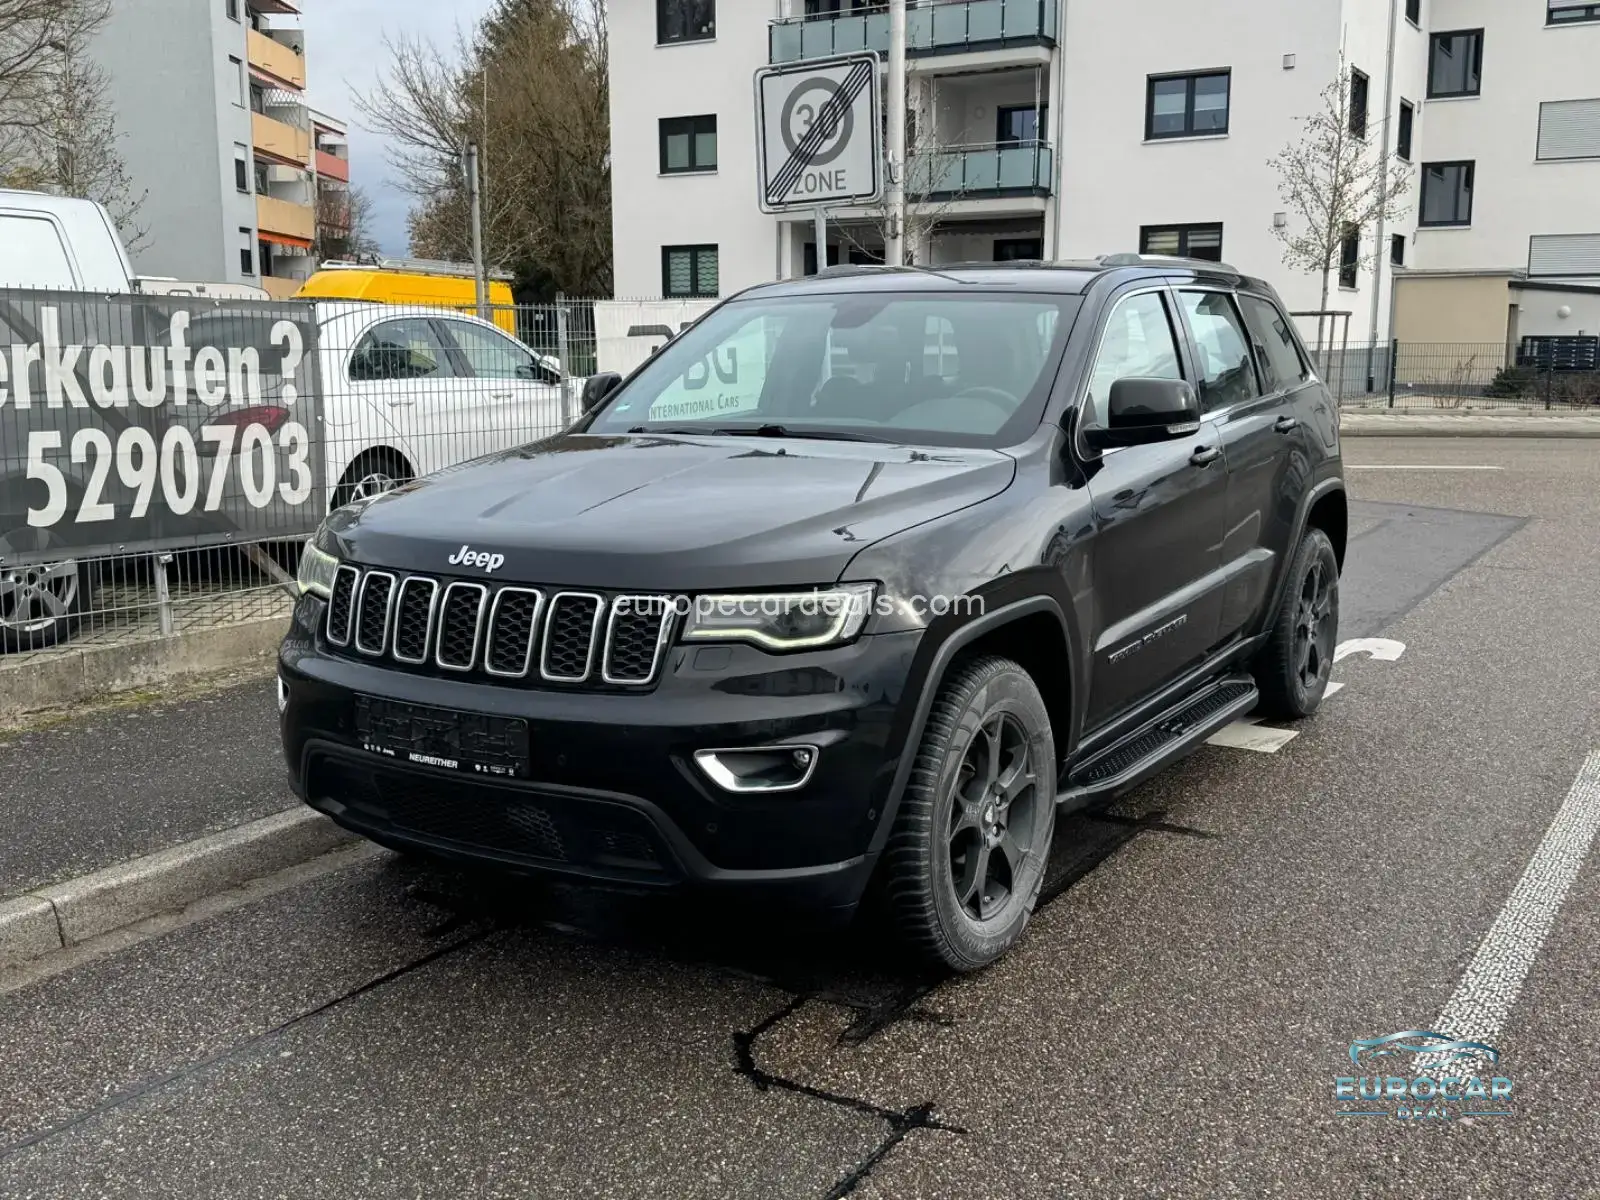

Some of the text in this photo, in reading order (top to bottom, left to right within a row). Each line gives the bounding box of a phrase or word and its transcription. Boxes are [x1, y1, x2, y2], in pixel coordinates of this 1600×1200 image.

[793, 169, 847, 194] ZONE
[0, 306, 261, 409] rkaufen
[26, 421, 312, 528] 5290703
[448, 544, 504, 573] Jeep
[409, 752, 458, 769] NEUREITHER
